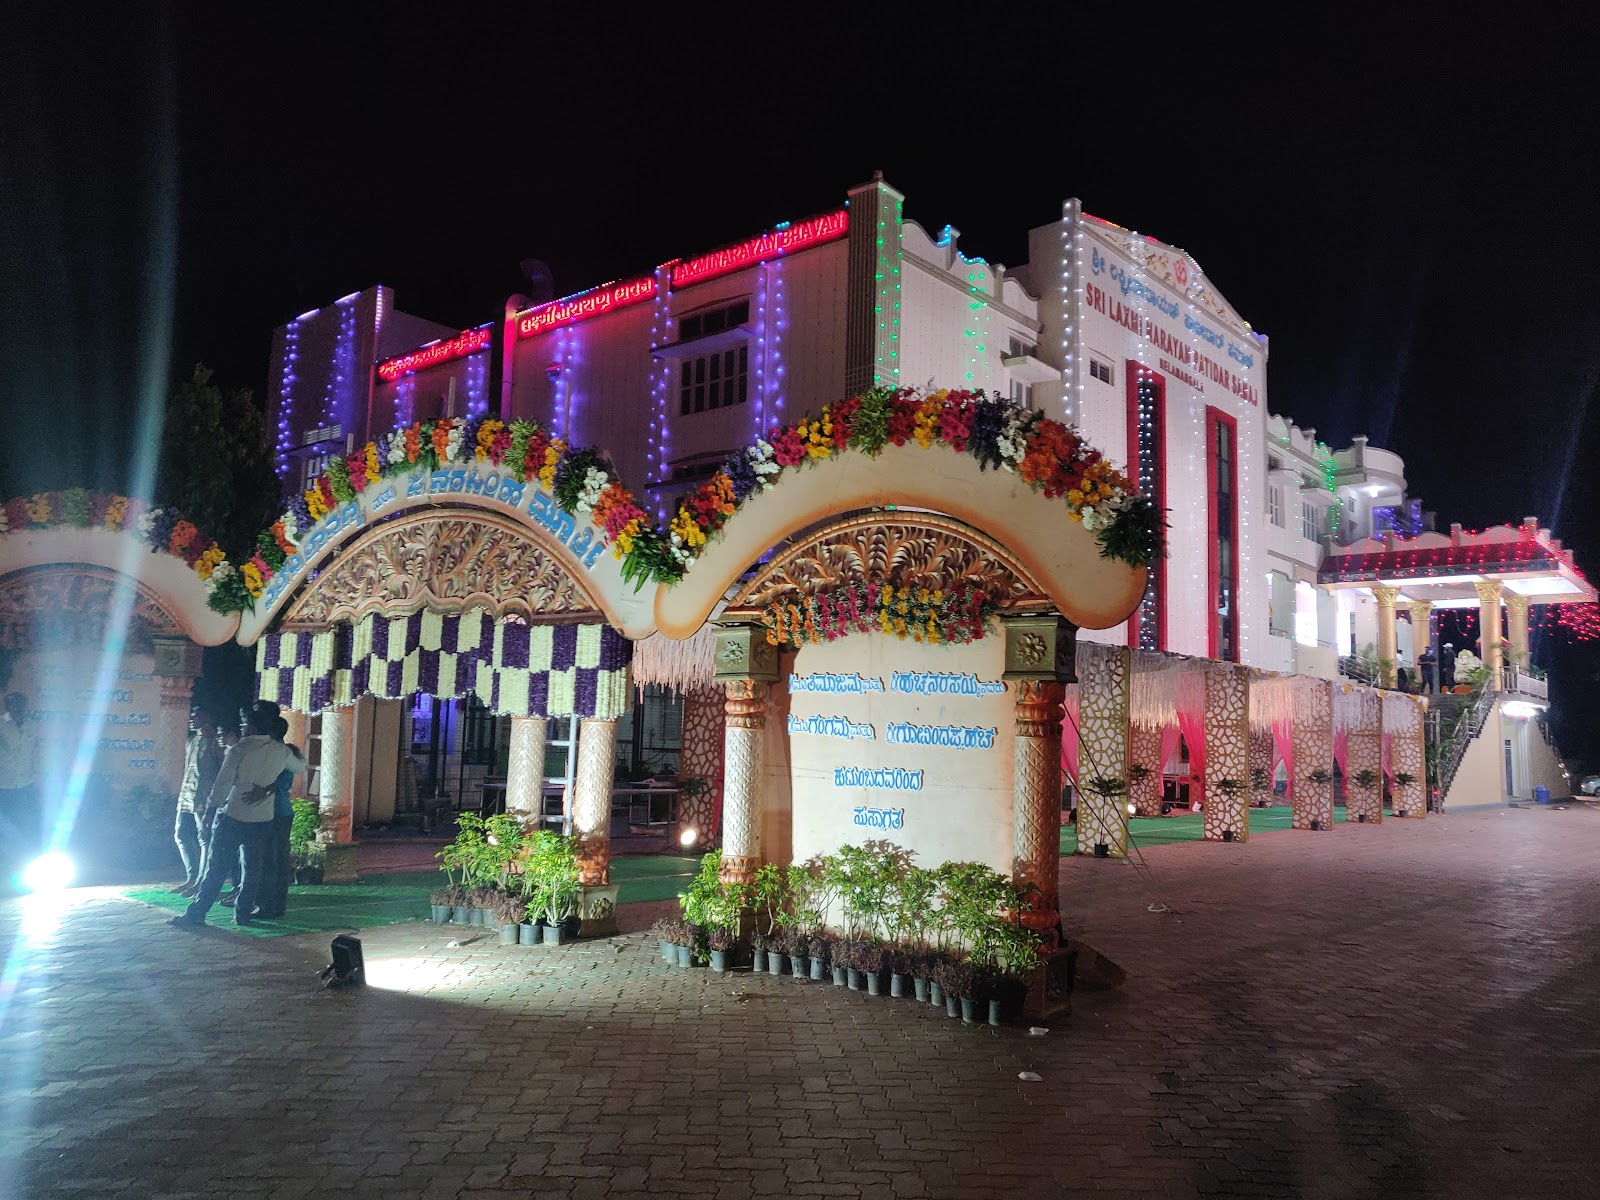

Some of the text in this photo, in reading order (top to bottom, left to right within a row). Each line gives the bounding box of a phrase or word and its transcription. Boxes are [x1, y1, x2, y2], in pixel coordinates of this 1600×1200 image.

[673, 211, 847, 281] LAXMINARAYAN BHAVAN
[1086, 281, 1258, 407] SRI LAXMI NARAYAN PATIDAR SAMAJ
[833, 767, 922, 791] ಕುಟುಂಬದವರಿಂದ
